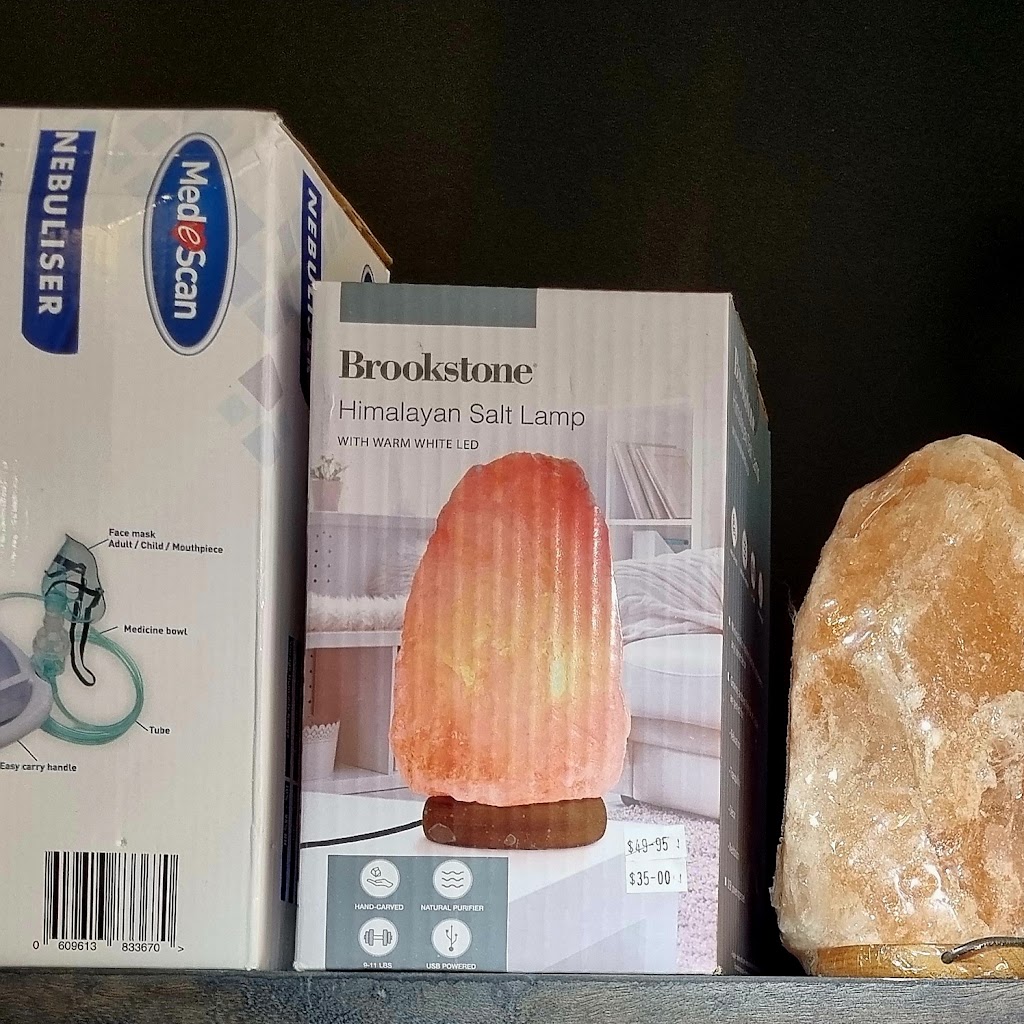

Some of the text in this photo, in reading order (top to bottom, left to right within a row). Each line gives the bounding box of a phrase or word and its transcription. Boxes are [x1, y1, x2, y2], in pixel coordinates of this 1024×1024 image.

[38, 131, 79, 315] NEBULISER
[339, 349, 533, 385] Brookstone
[339, 400, 586, 431] Himalayan Salt Lamp
[338, 436, 479, 450] WITH WARM WHITE LED
[108, 528, 156, 539] Face mask
[108, 539, 224, 554] Adult Child Mouthpiece
[124, 625, 188, 636] Medicine bowl
[150, 725, 170, 735] Tube
[0, 763, 77, 774] Easy carry handle
[629, 870, 671, 886] $35-00
[354, 903, 404, 911] HAND-CARVED
[58, 941, 97, 951] 609613
[122, 942, 160, 952] 833670
